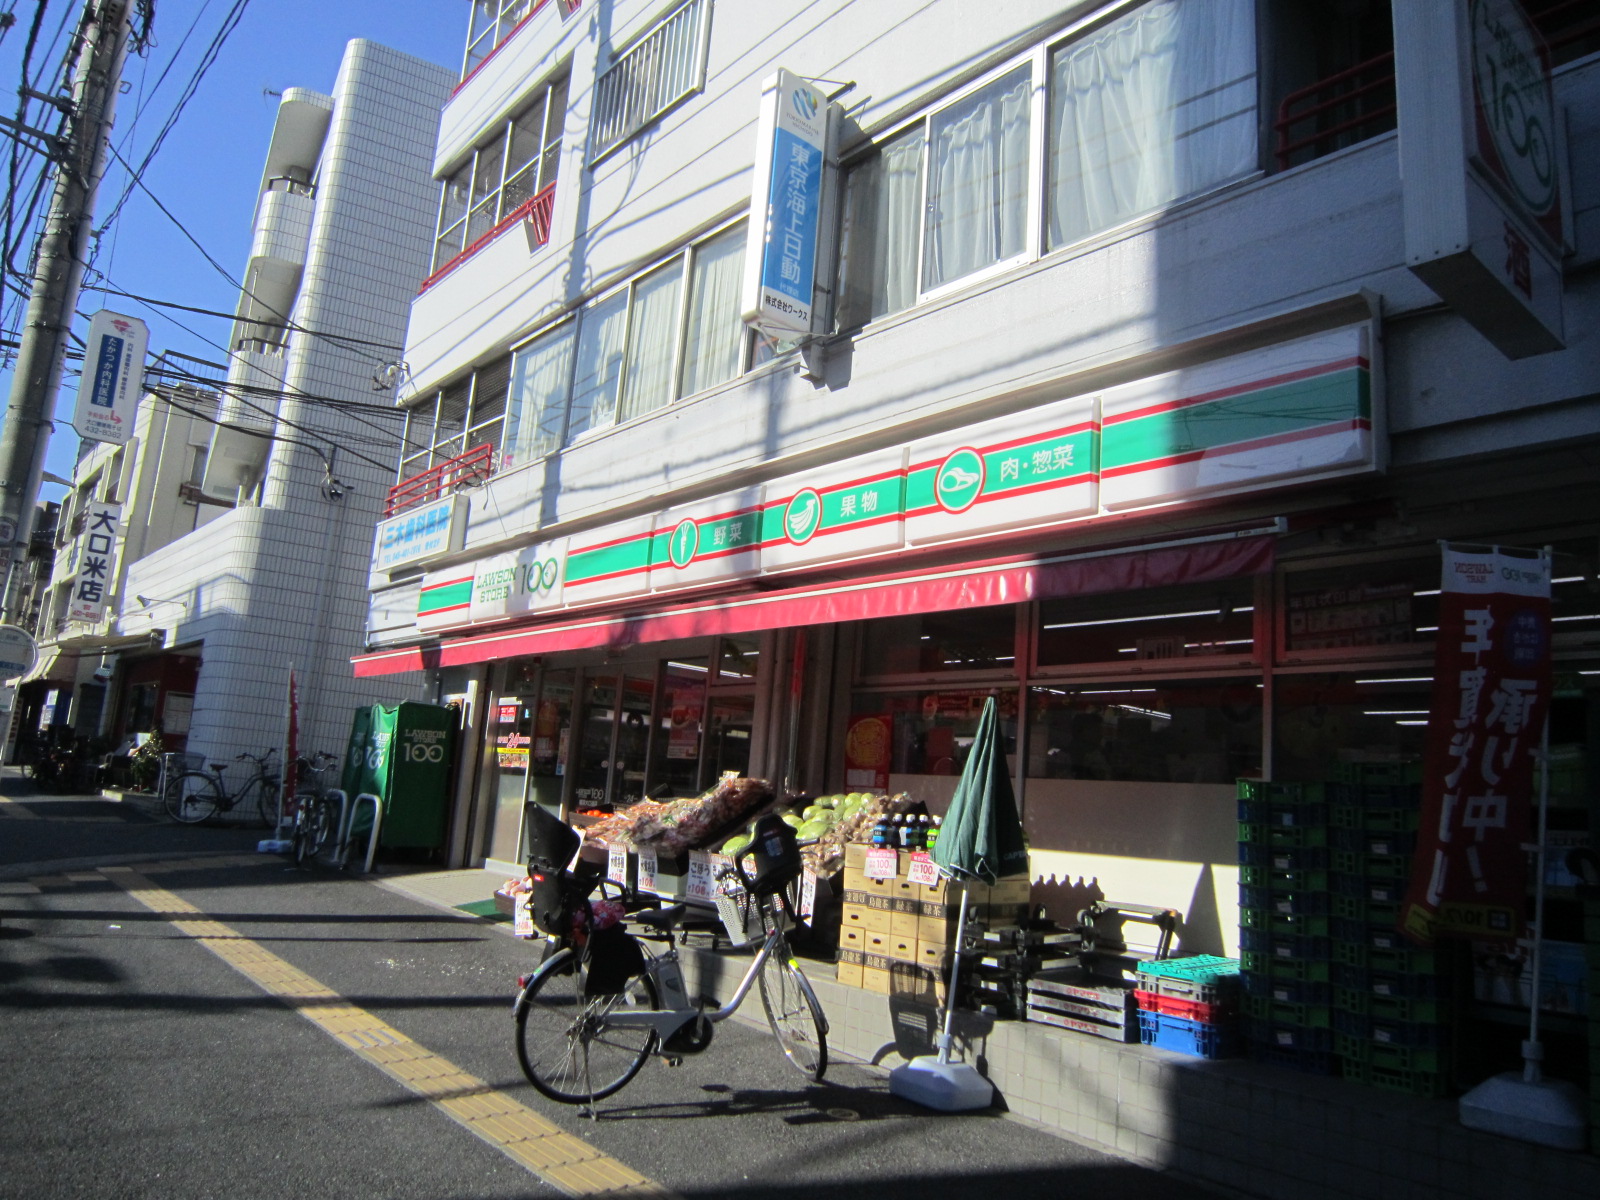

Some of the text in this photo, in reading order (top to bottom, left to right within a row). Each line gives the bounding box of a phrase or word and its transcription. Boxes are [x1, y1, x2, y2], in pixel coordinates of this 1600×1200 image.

[780, 141, 811, 285] 東京海上日動
[765, 294, 808, 322] 株式会社ワークス
[840, 490, 878, 518] 果物
[383, 504, 449, 549] 三木歯科医院
[713, 521, 743, 546] 野菜
[76, 509, 117, 603] 大口米店
[476, 557, 559, 595] LAWSON 100
[480, 585, 510, 603] STORE
[404, 729, 447, 739] LAWSON
[403, 742, 445, 763] 100
[690, 862, 710, 877] ごぼう
[922, 903, 941, 917] 緑茶
